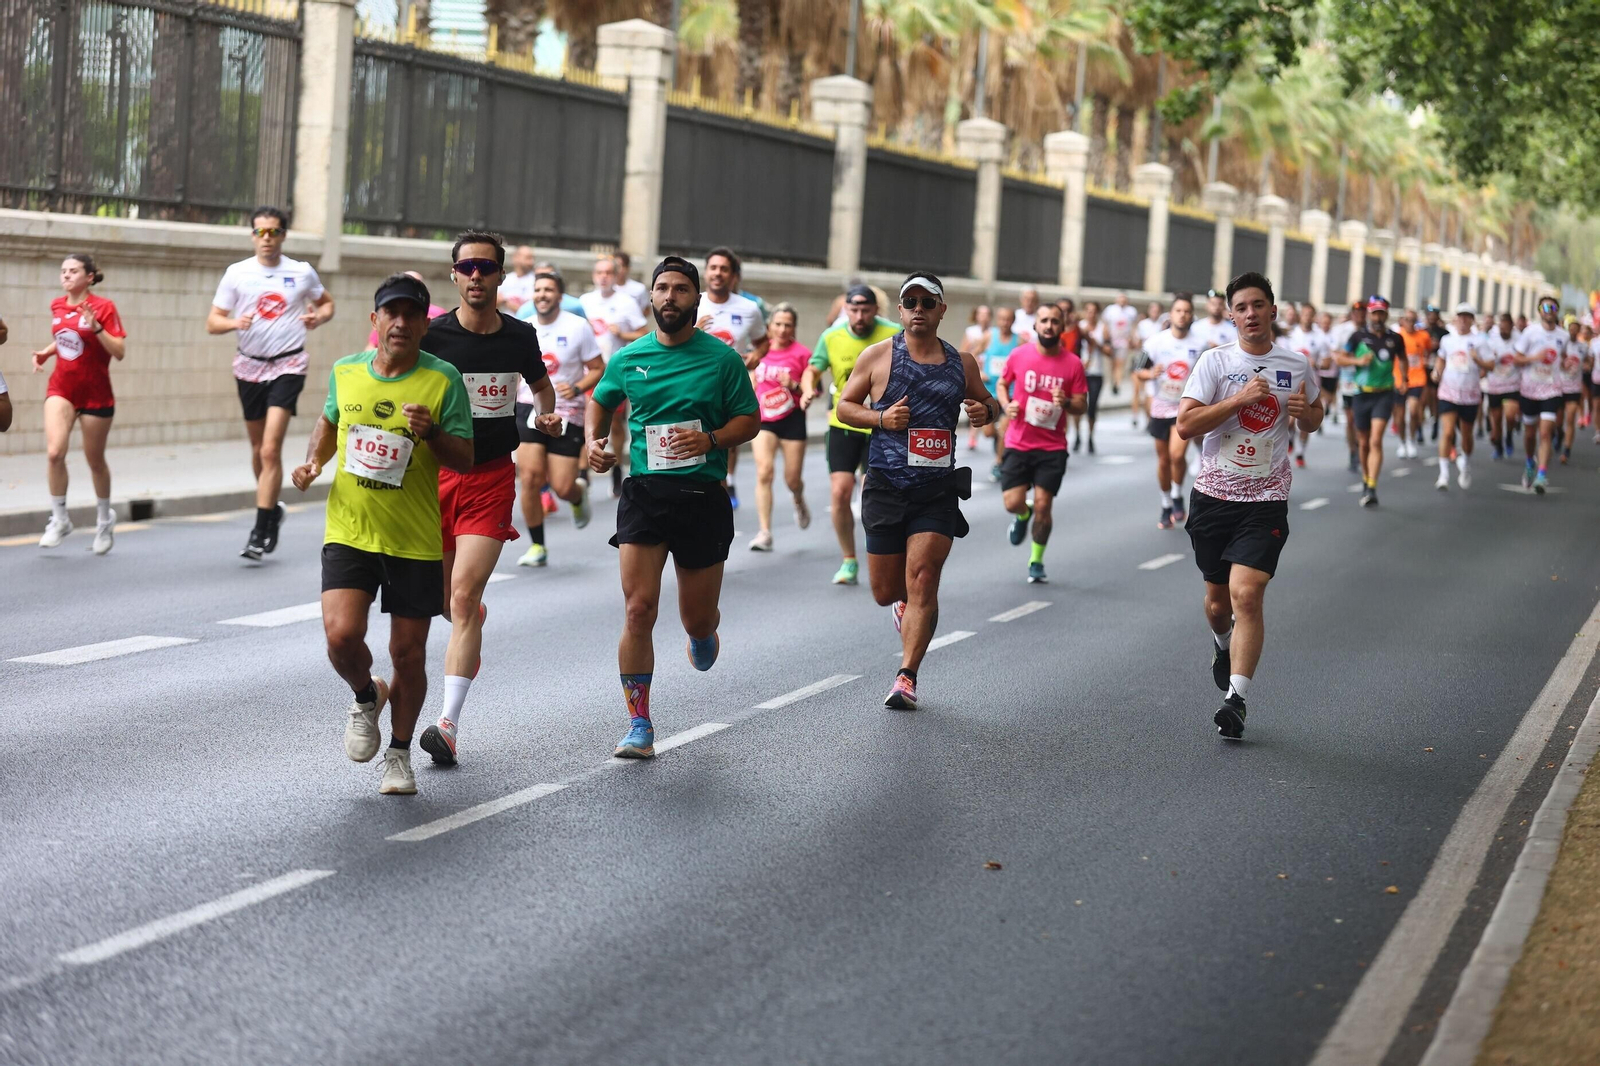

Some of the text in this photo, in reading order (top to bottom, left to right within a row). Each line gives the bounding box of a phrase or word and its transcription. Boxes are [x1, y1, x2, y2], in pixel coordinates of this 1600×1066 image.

[477, 385, 508, 397] 464
[1243, 409, 1271, 424] FRENO
[354, 438, 399, 461] 1051
[916, 438, 947, 449] 2064
[1236, 444, 1256, 456] 39
